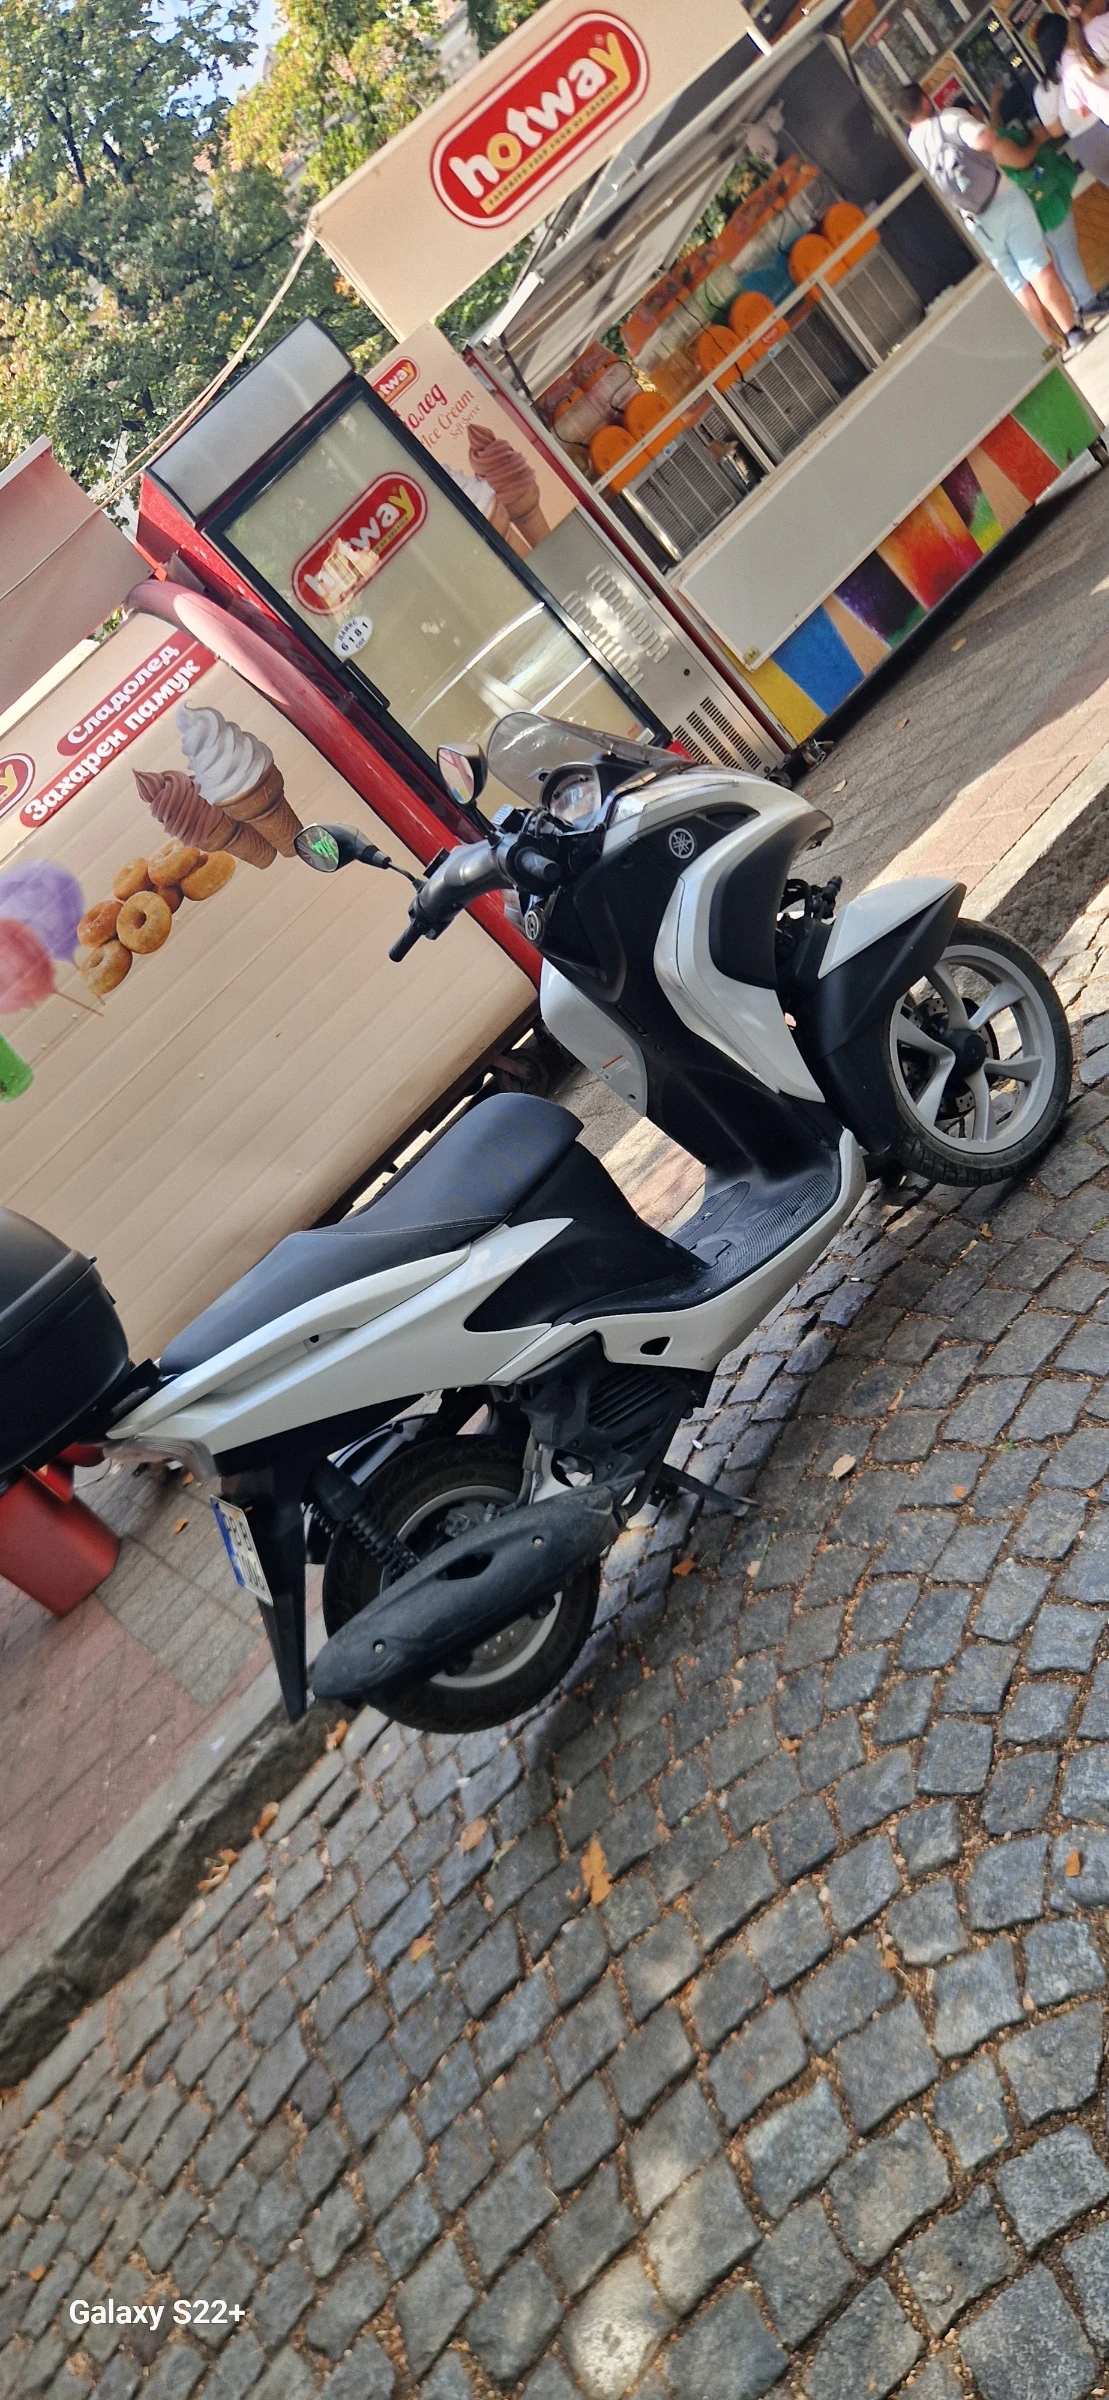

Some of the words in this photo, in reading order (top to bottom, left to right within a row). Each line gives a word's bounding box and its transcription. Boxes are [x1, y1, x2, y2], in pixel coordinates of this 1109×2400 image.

[449, 32, 631, 198] hotway
[403, 384, 449, 431] олед
[420, 427, 442, 450] Ice
[437, 389, 476, 431] Cream
[24, 728, 128, 821] Захарен
[123, 659, 201, 731] памук
[67, 645, 180, 744] Сладолед
